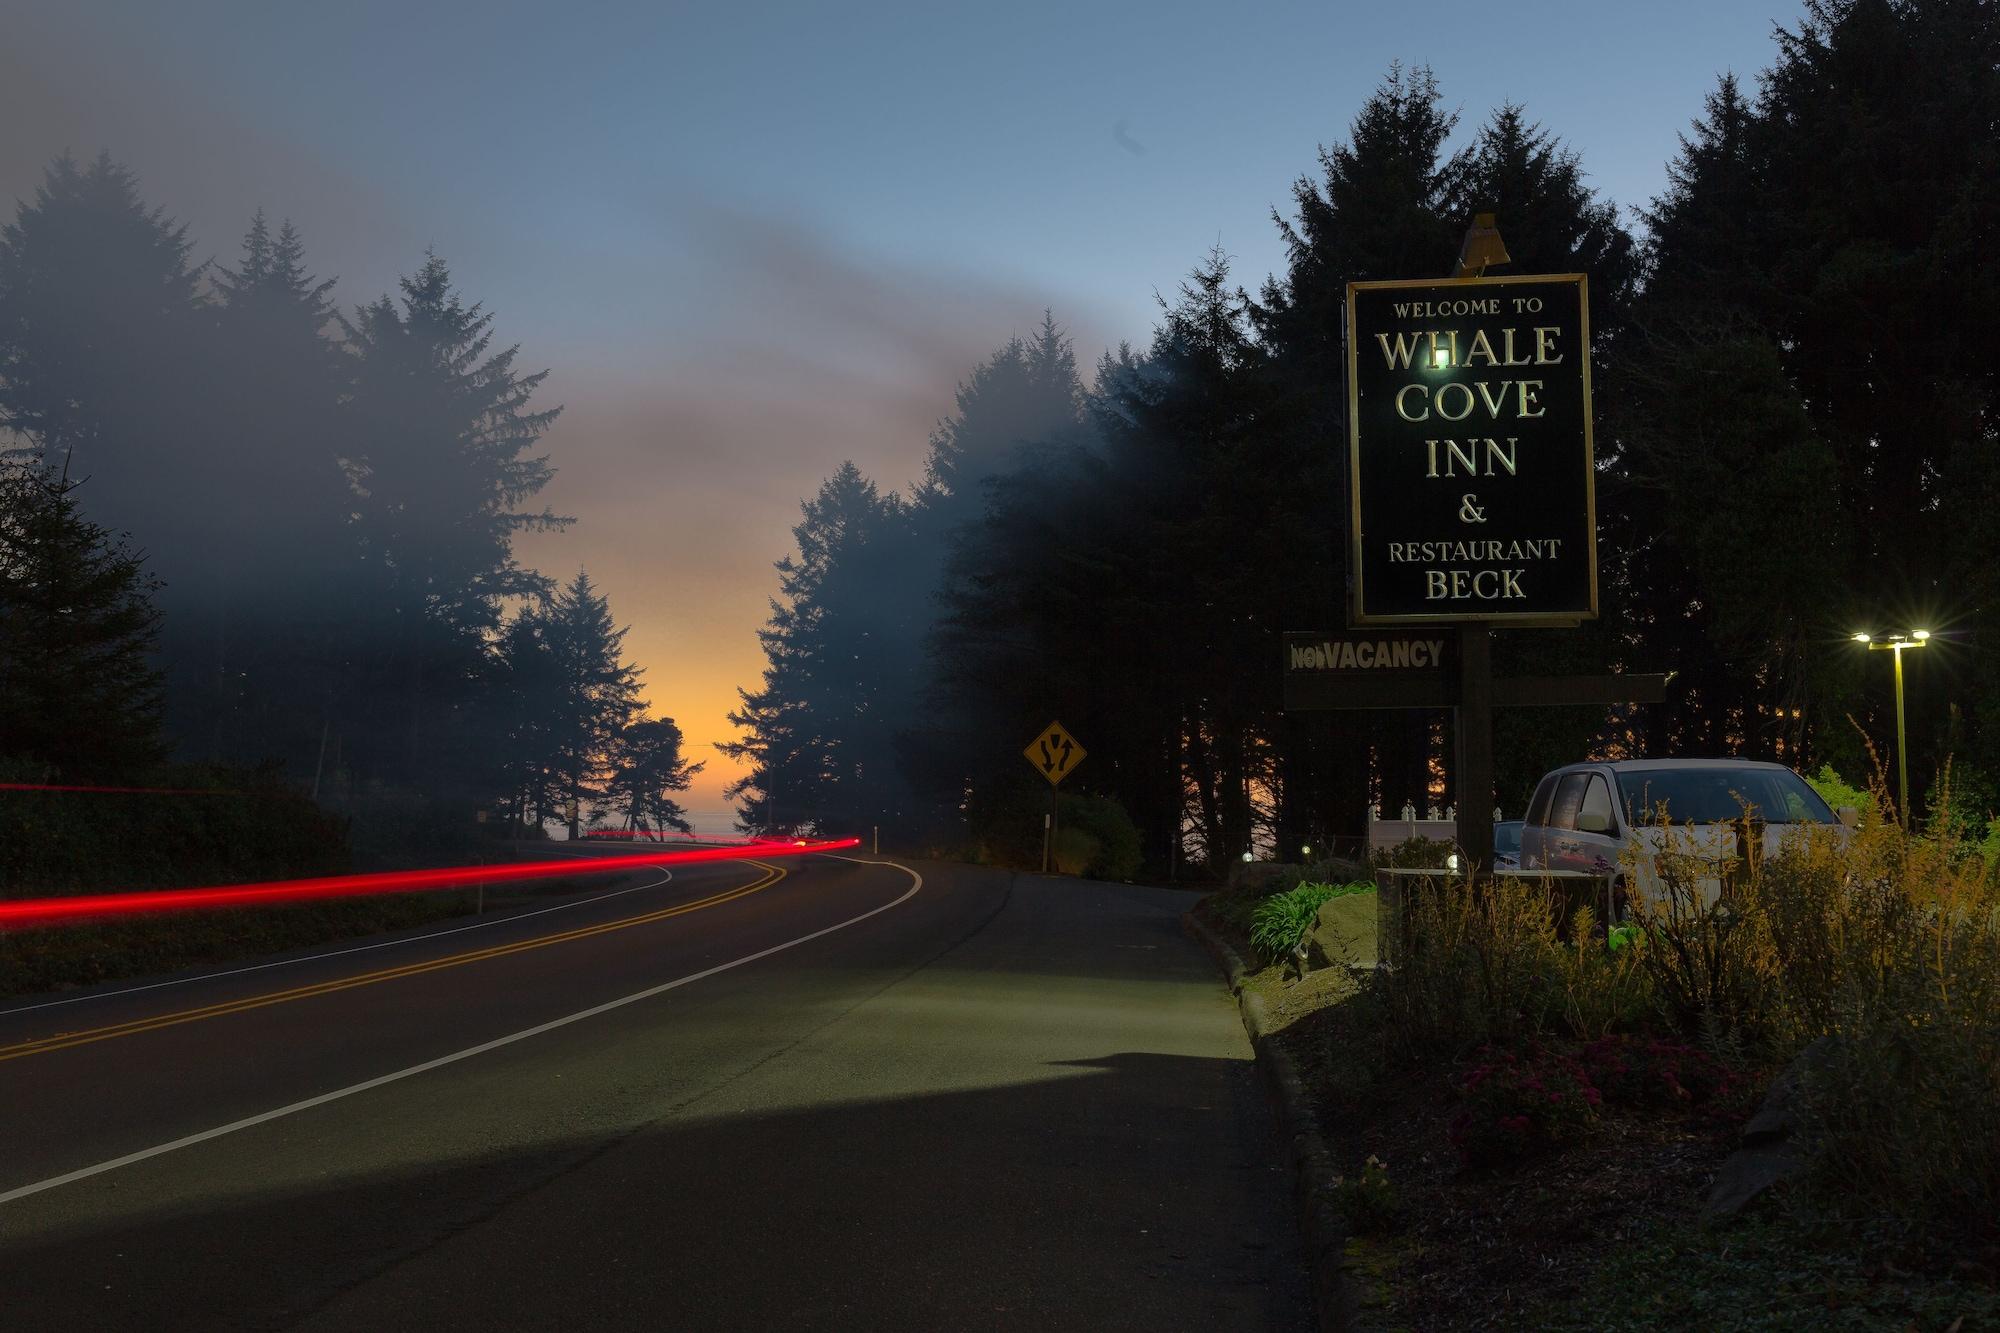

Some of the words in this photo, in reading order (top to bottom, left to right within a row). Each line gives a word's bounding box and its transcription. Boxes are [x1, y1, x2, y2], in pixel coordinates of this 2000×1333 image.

[1393, 299, 1500, 318] WELCOME
[1513, 298, 1543, 314] TO
[1375, 327, 1563, 370] WHALE
[1395, 380, 1546, 422] COVE
[1425, 437, 1518, 478] INN
[1459, 493, 1487, 524] &
[1388, 539, 1561, 562] RESTAURANT
[1425, 569, 1527, 600] BECK
[1323, 640, 1444, 669] VACANCY
